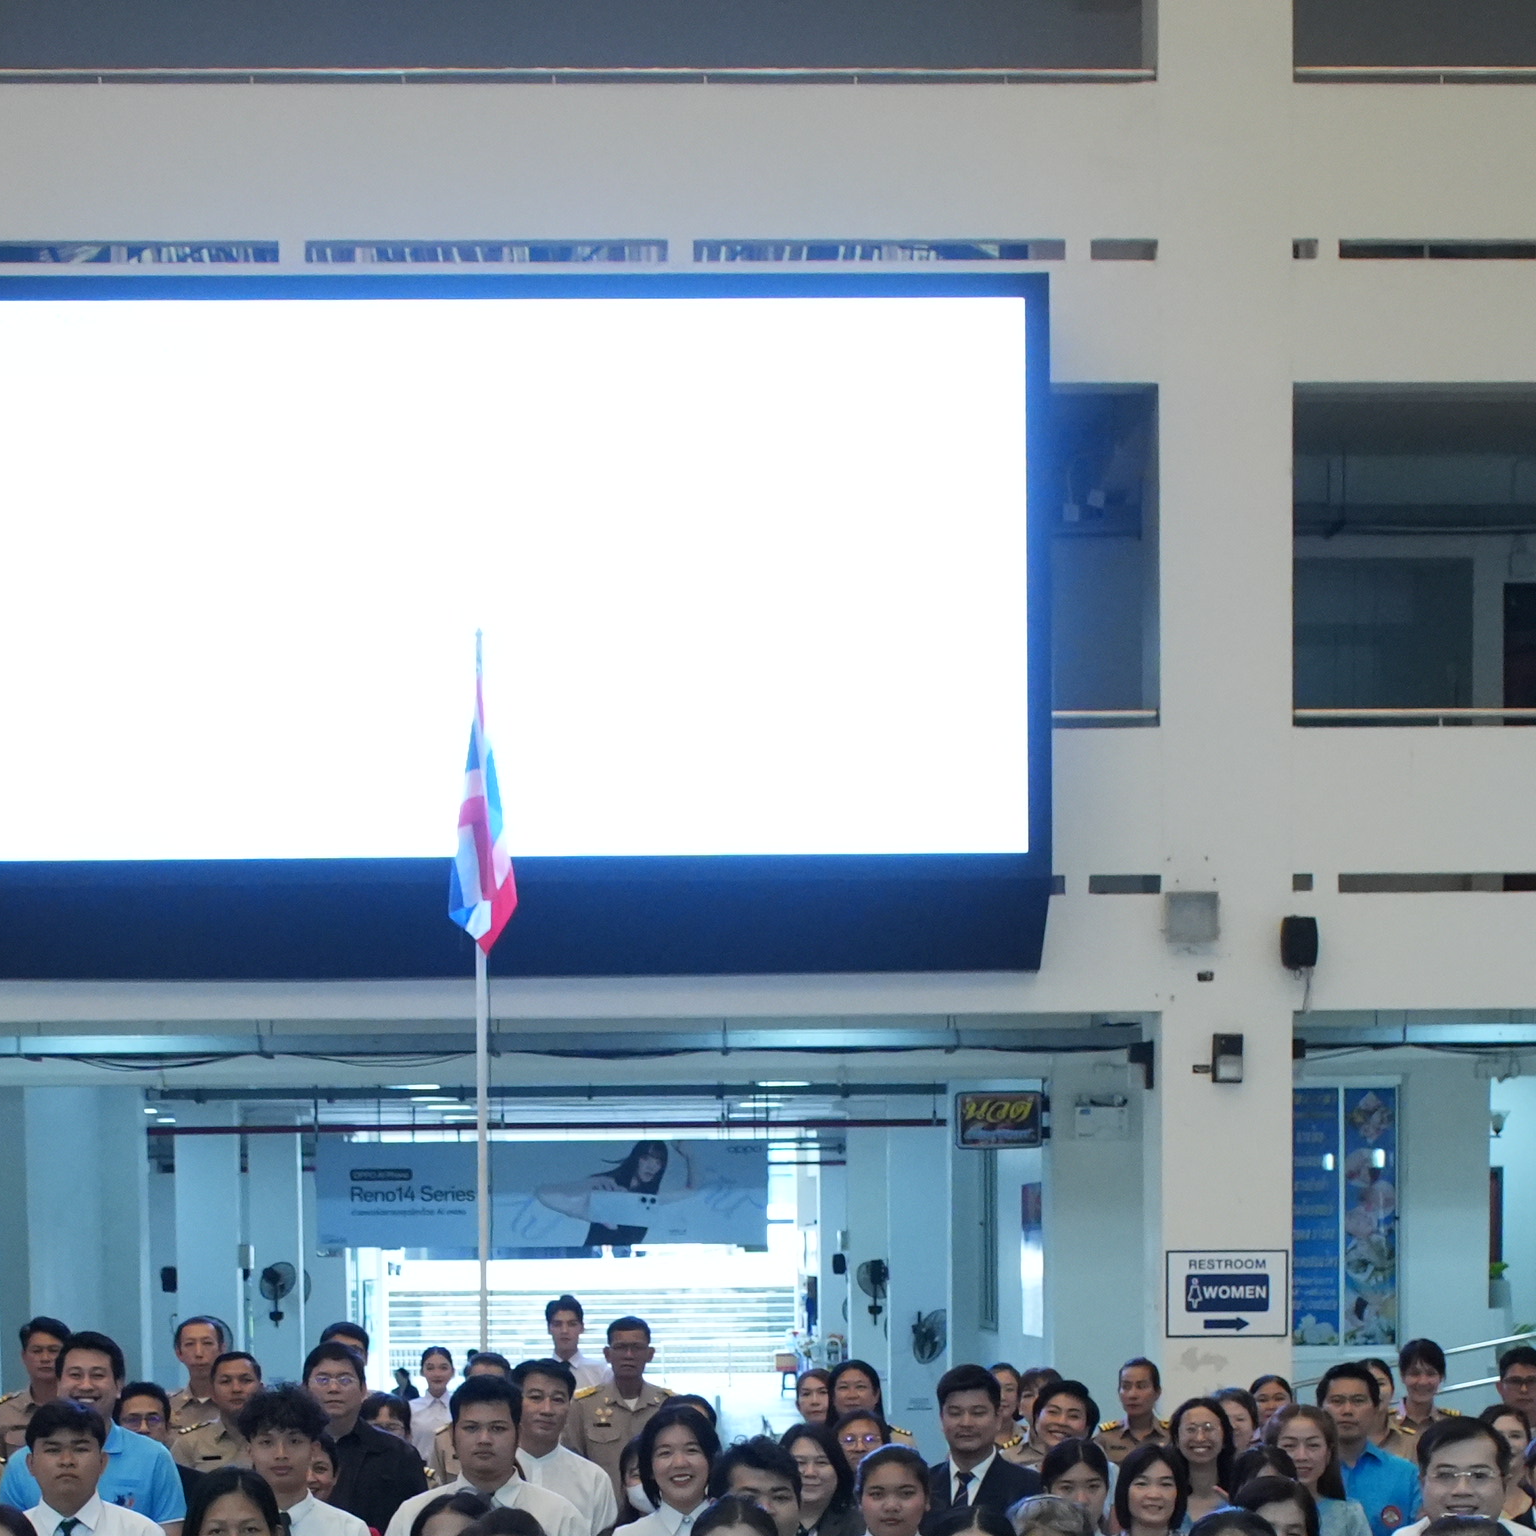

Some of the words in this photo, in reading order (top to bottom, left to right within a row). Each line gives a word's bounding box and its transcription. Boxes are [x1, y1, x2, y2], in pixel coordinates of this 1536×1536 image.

[351, 1186, 415, 1202] Reno14
[420, 1185, 476, 1202] Series
[1188, 1259, 1266, 1270] RESTROOM
[1203, 1285, 1267, 1299] WOMEN
